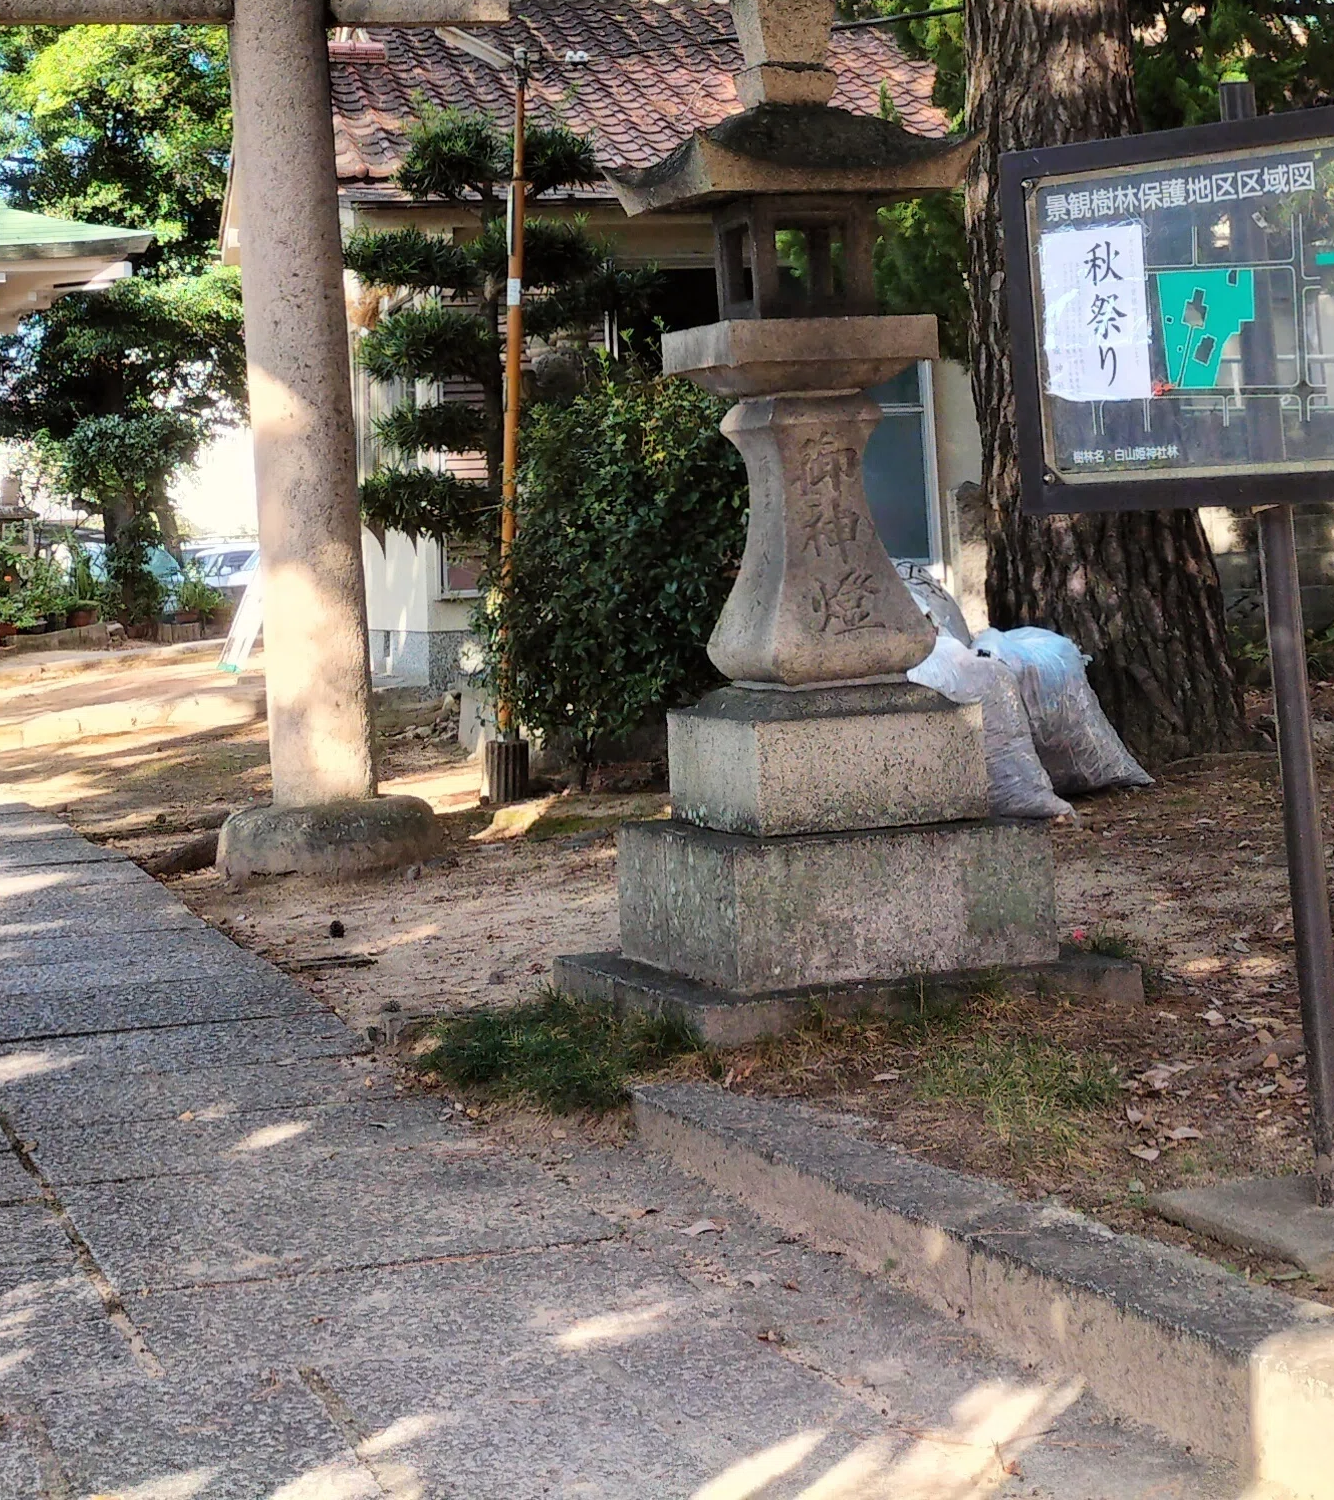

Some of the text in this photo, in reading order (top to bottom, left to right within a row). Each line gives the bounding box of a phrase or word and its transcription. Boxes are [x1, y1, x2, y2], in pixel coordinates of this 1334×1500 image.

[1044, 161, 1316, 223] 景観樹林保護地区区域図
[1083, 240, 1128, 387] 秋祭り
